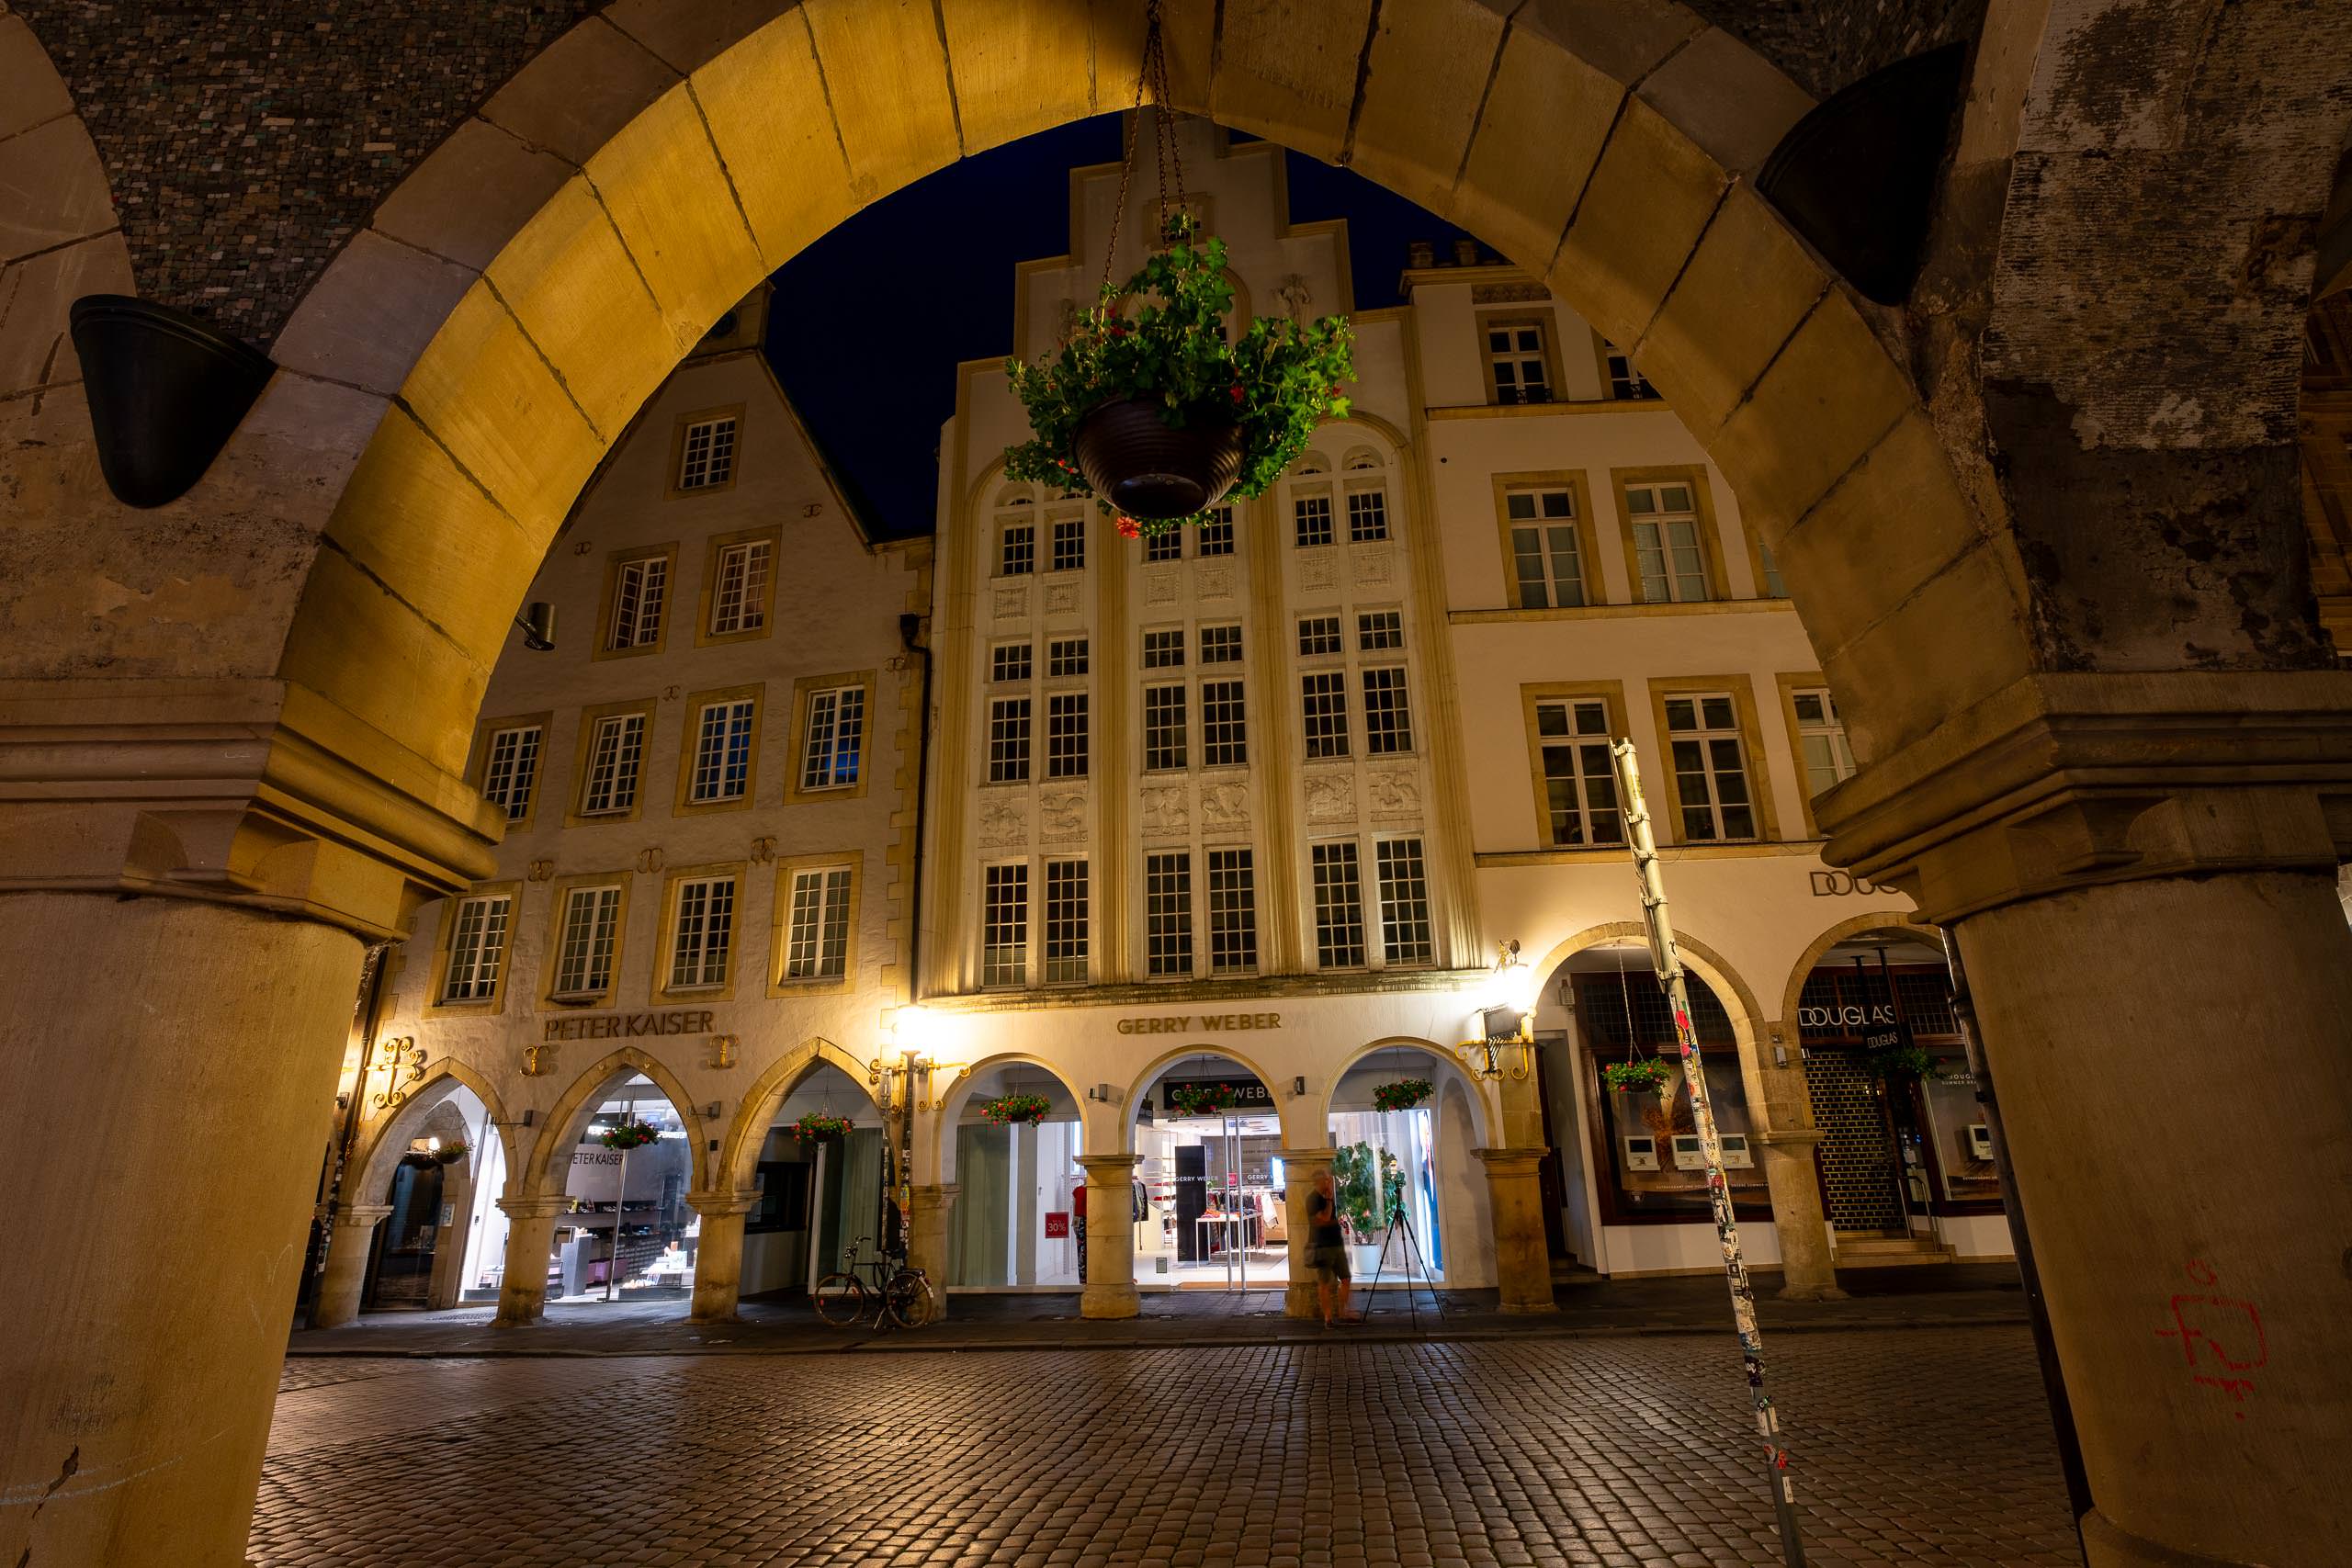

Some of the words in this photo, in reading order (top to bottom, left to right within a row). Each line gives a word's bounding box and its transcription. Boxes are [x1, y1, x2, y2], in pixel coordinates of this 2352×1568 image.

[1116, 1016, 1192, 1035] GERRY
[1201, 1012, 1282, 1032] WEBER
[1798, 1005, 1895, 1026] DOUGLAS
[544, 1015, 621, 1042] PETER
[626, 1010, 714, 1038] KAISER
[1867, 1032, 1898, 1048] DOUGLAS
[573, 1152, 594, 1165] ETER
[1047, 1223, 1067, 1232] 30%
